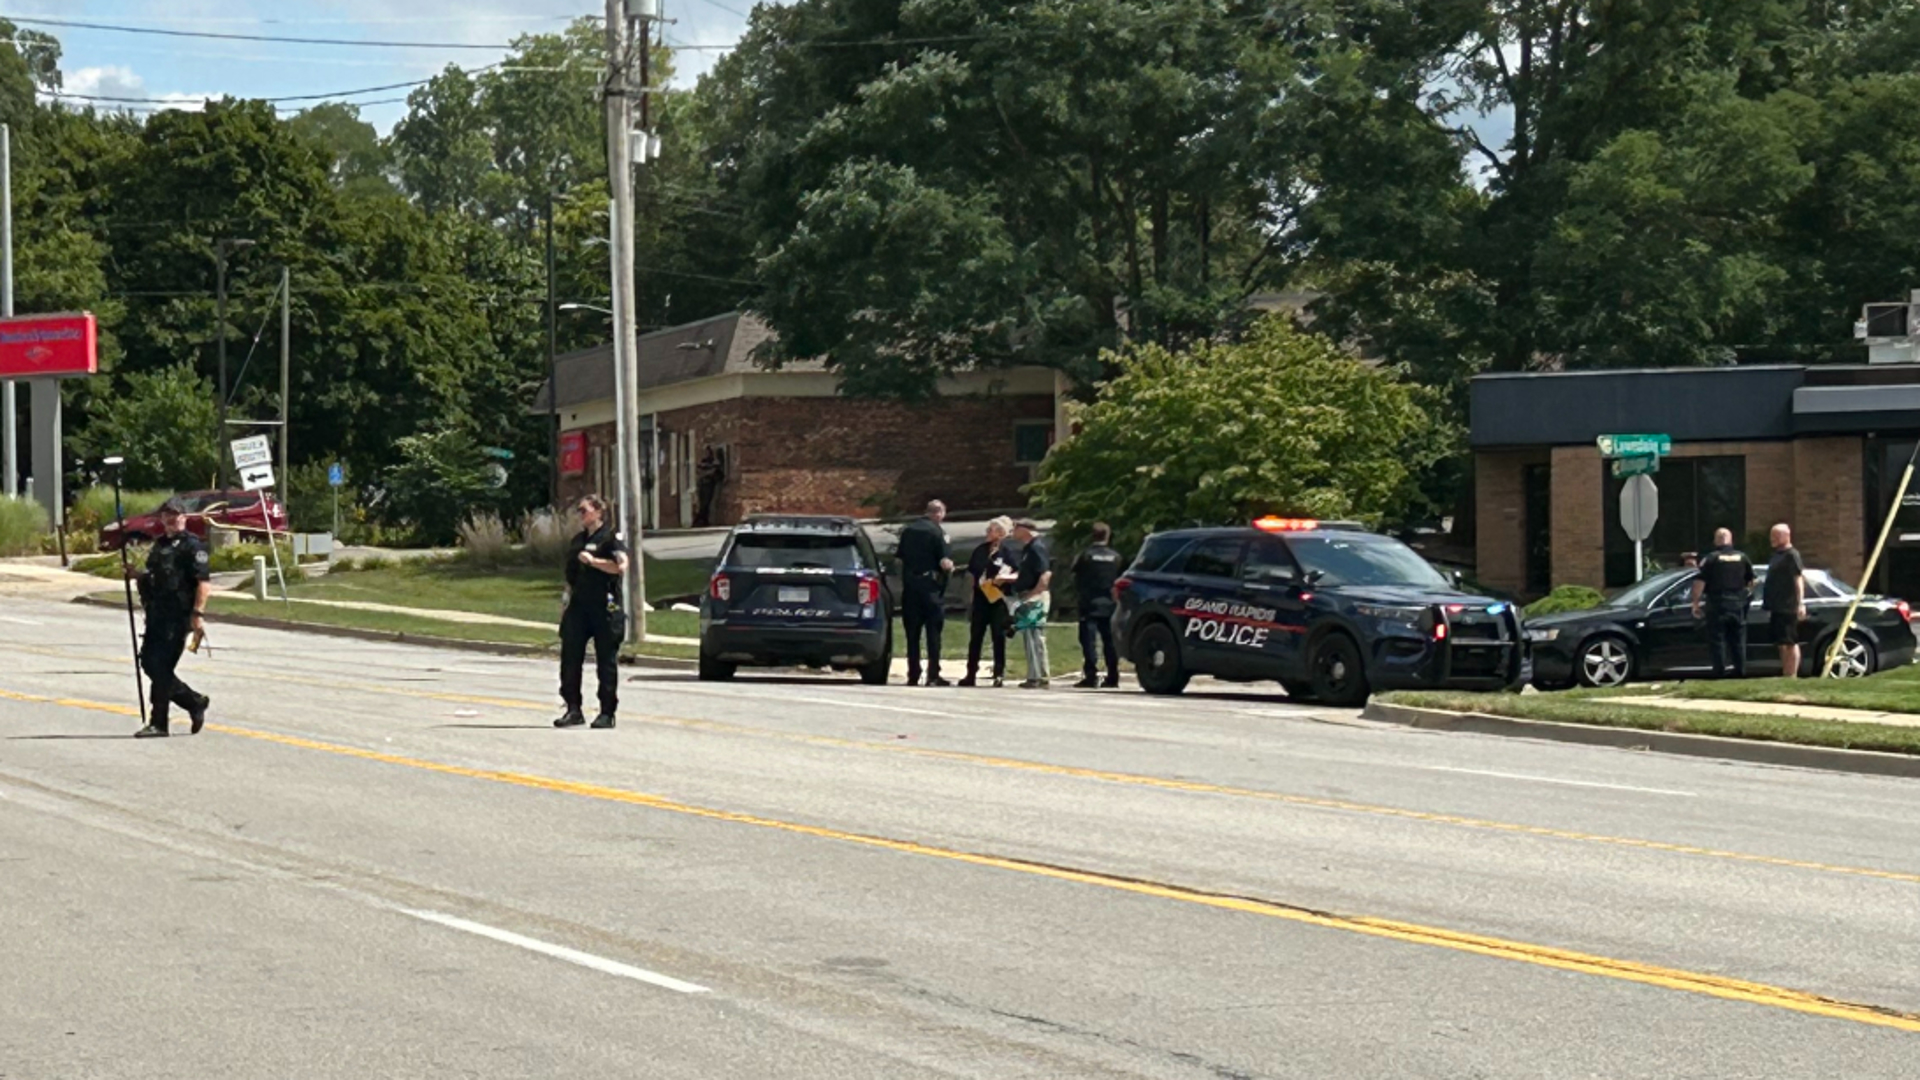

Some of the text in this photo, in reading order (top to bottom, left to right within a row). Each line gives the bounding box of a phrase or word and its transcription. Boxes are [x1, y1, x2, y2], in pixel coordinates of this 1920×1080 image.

[1184, 597, 1277, 622] GRAND RAPIDS
[1184, 617, 1270, 648] POLICE
